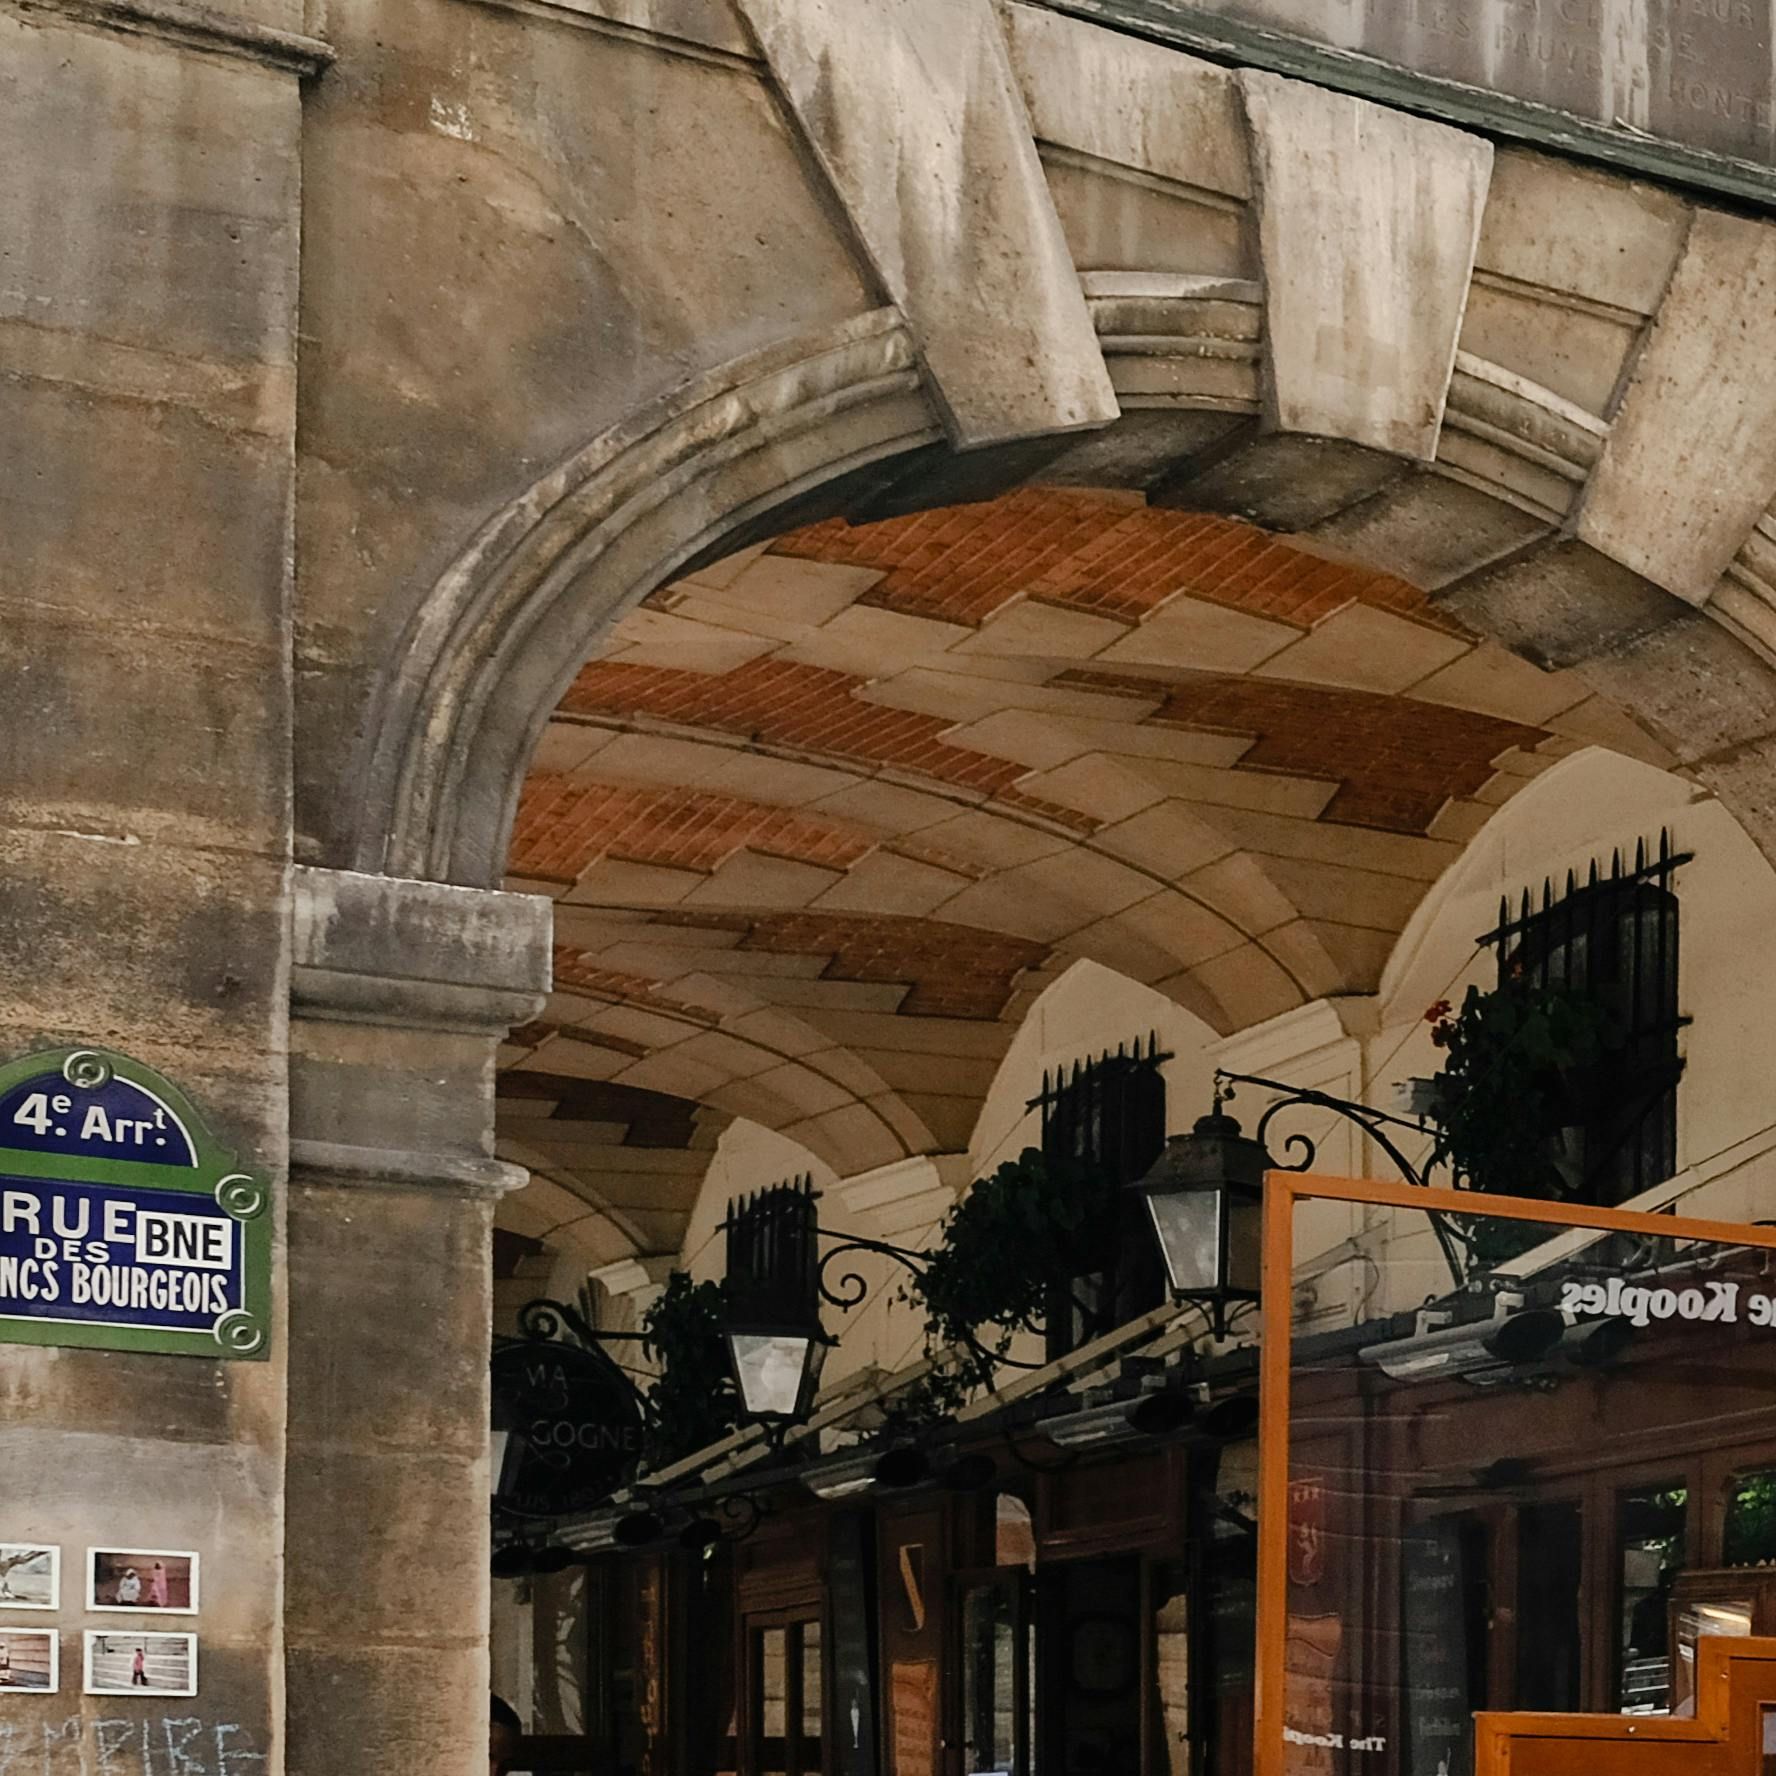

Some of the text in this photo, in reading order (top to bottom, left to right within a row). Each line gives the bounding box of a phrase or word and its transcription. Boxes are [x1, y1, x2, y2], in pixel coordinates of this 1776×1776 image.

[3, 1191, 136, 1244] RUE
[145, 1218, 224, 1262] BNE
[35, 1238, 110, 1264] DES
[72, 1262, 228, 1314] BOURGEOIS
